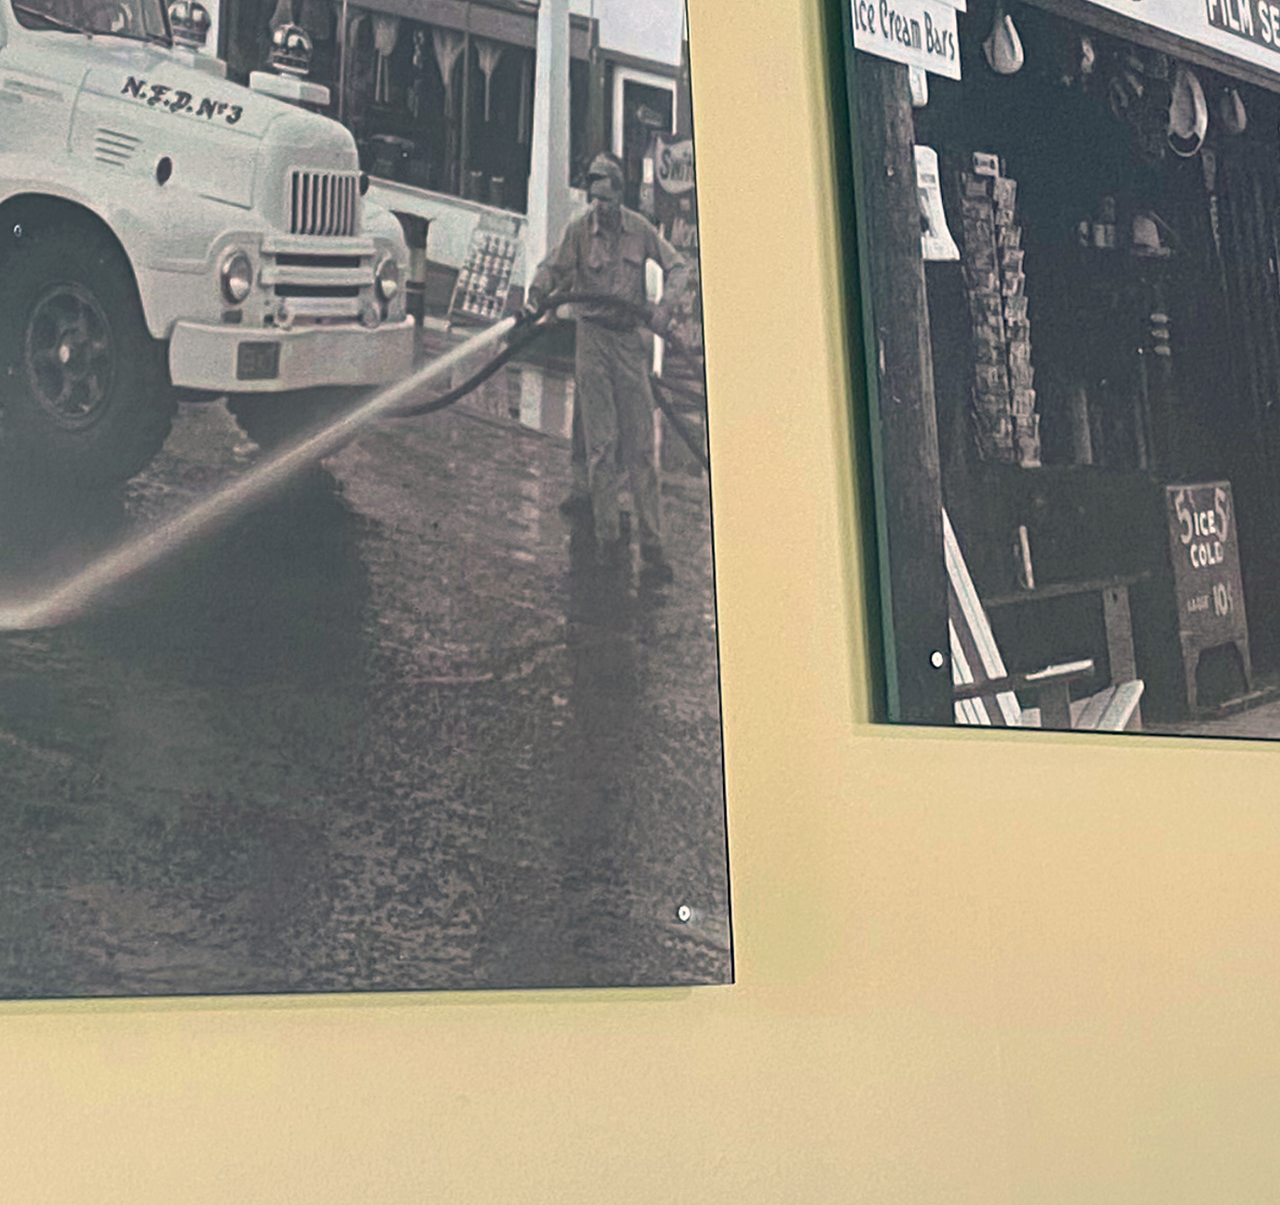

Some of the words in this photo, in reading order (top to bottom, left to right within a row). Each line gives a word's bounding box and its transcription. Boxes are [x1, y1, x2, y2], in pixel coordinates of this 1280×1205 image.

[923, 10, 956, 61] Bars
[1193, 509, 1216, 537] ICE
[1190, 540, 1224, 569] COLD
